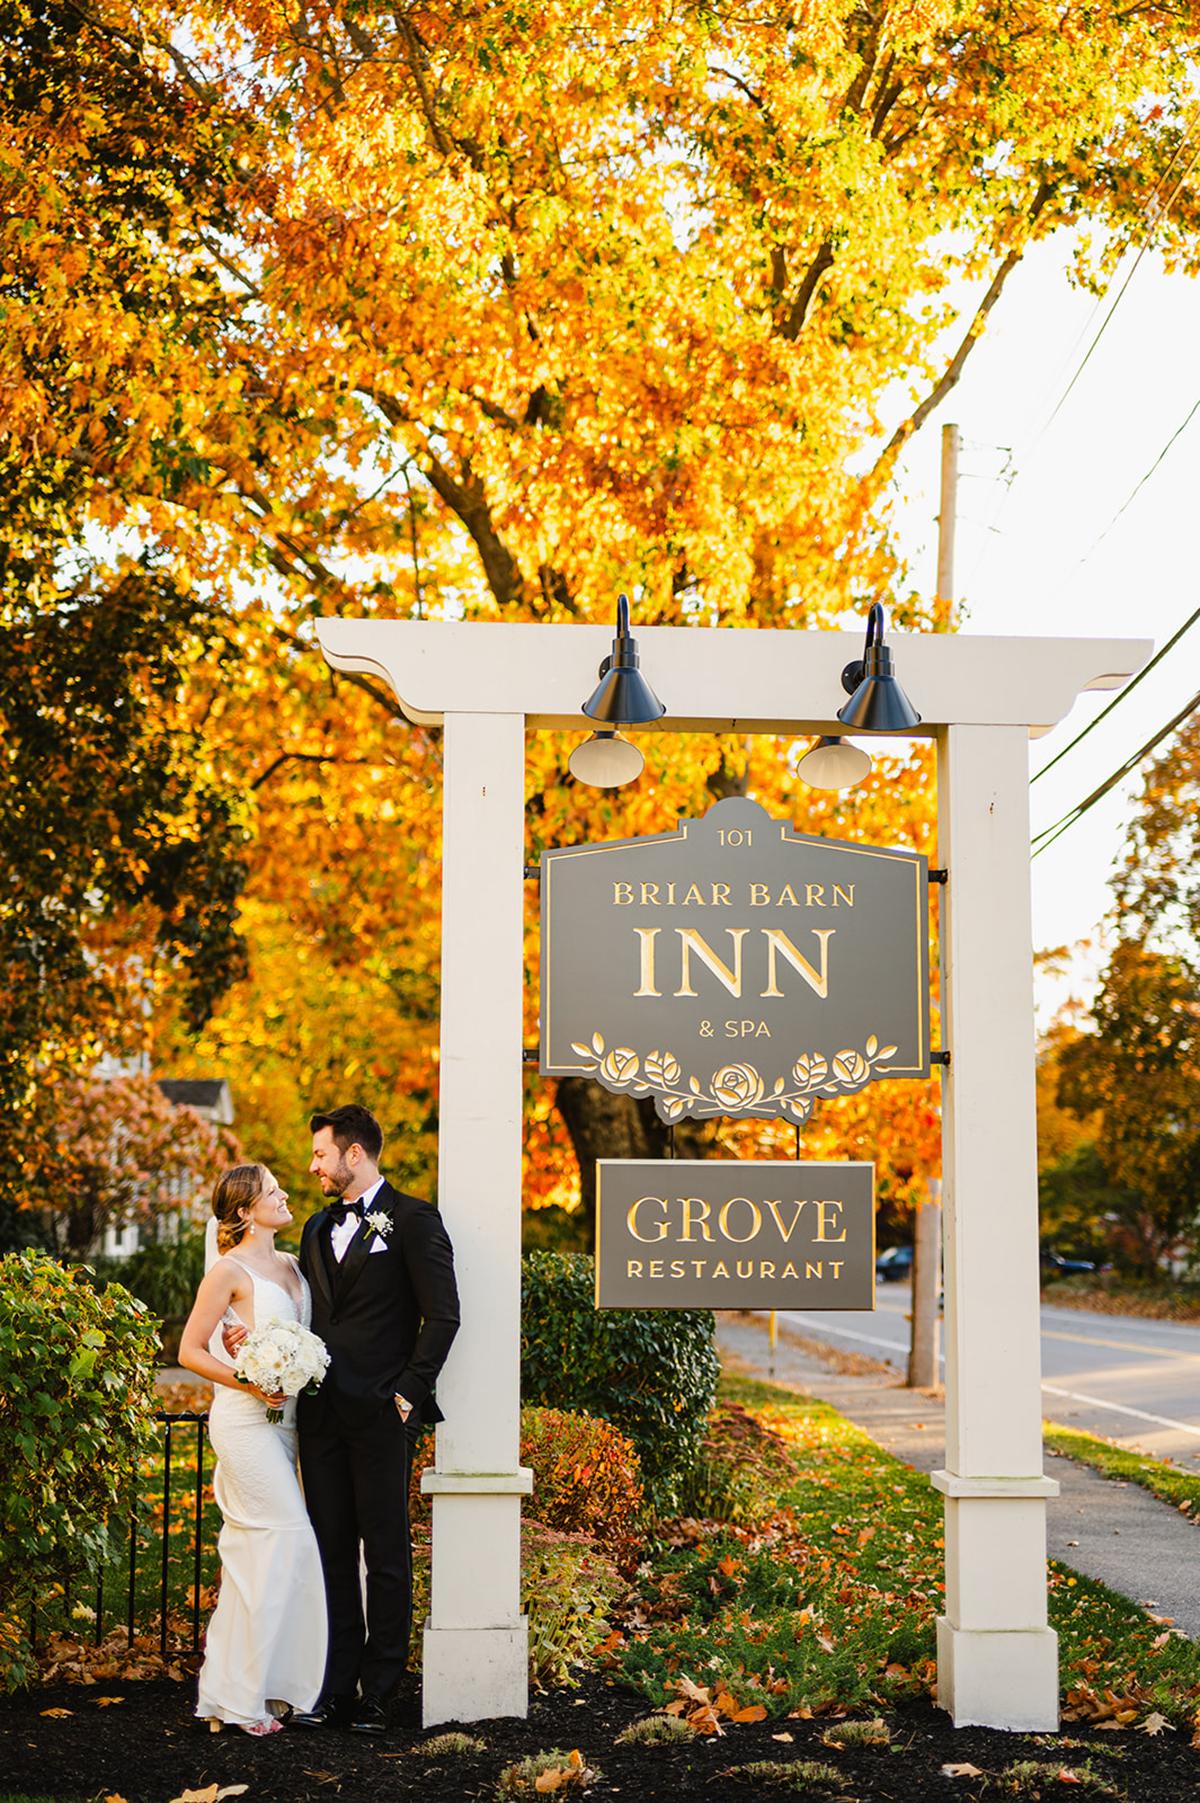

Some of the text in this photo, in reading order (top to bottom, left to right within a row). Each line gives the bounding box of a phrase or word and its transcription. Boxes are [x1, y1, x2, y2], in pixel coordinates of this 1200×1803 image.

[716, 829, 752, 847] 101
[612, 881, 856, 907] BRIAR BARN
[632, 927, 837, 999] INN
[699, 1020, 771, 1038] & SPA
[626, 1197, 847, 1243] GROVE
[627, 1260, 845, 1279] RESTAURANT
